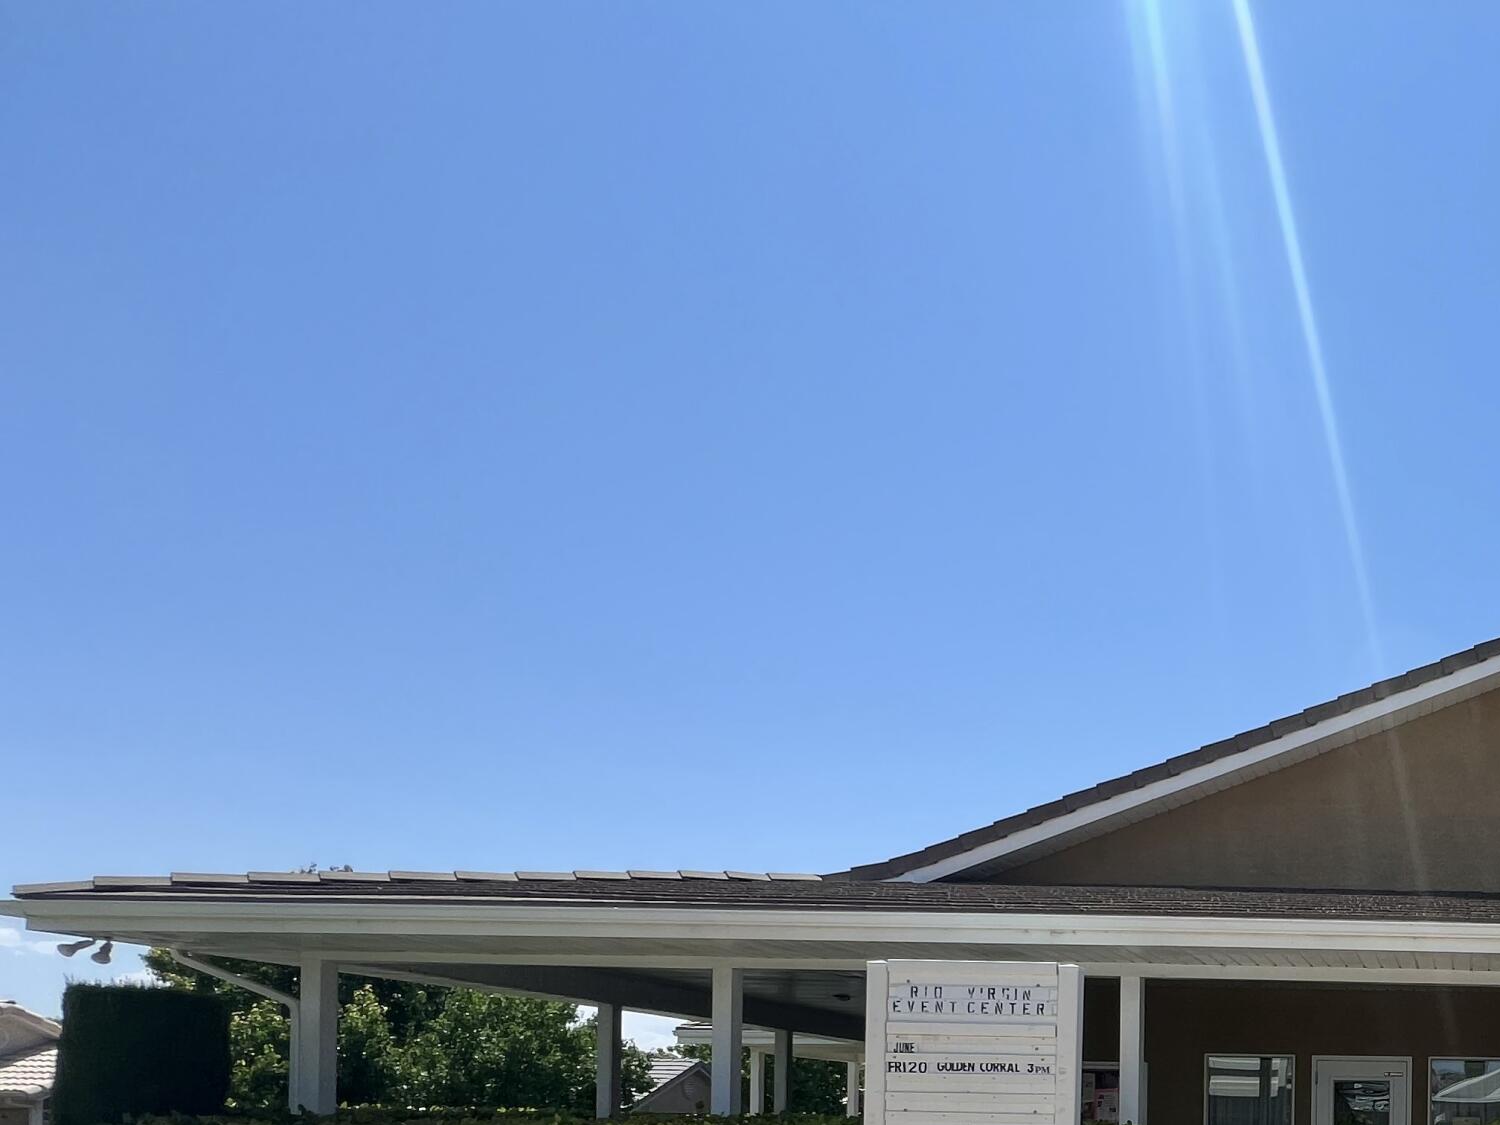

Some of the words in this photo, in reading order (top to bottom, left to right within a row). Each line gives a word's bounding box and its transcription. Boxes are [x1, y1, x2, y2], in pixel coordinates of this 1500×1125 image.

[910, 986, 943, 999] RIO
[967, 987, 1032, 1001] VIRGIN
[892, 1000, 957, 1014] EVENT
[967, 1002, 1045, 1015] CENTER
[893, 1042, 915, 1053] JUNE
[937, 1062, 975, 1072] GOLDEN
[980, 1062, 1020, 1073] CORRAL
